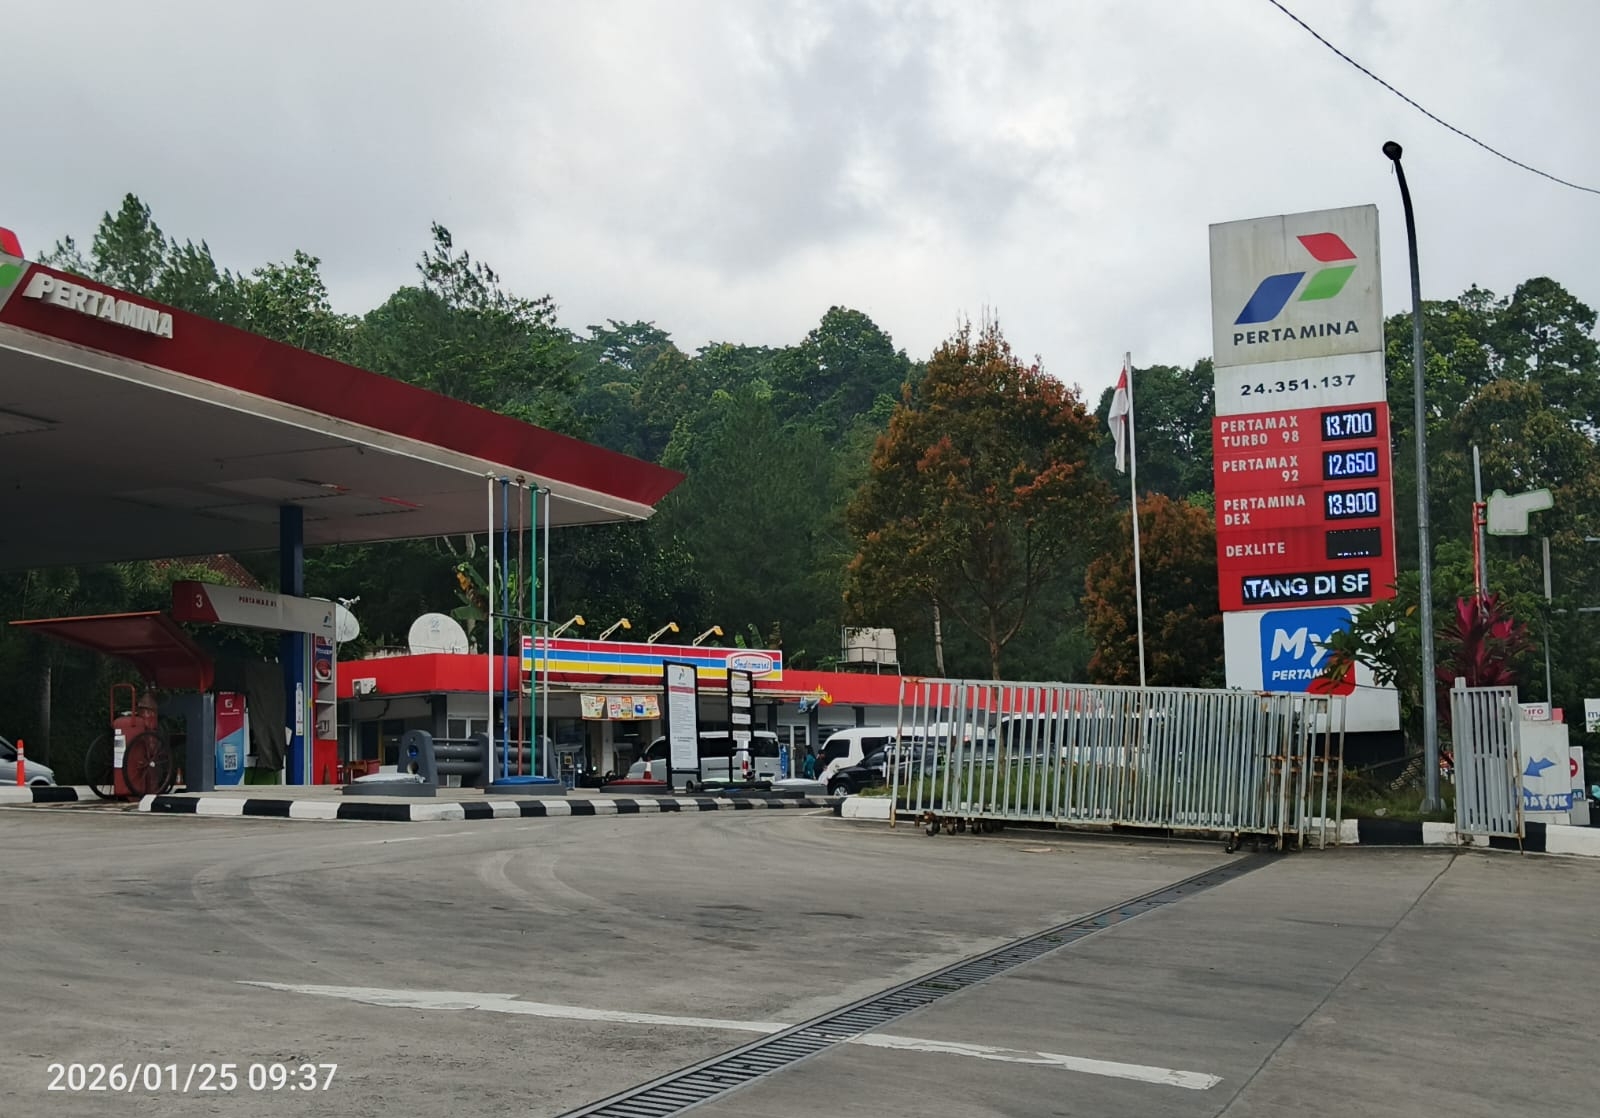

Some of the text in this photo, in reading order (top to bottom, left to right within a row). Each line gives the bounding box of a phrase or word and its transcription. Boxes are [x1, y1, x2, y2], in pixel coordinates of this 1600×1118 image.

[22, 272, 173, 339] PERTAMINA
[1233, 320, 1359, 346] PERTAMINA
[1240, 374, 1356, 396] 24.351.137
[1221, 415, 1298, 433] PERTAMAX
[1326, 412, 1372, 436] 13.700
[1222, 430, 1300, 447] TURBO 98
[1222, 455, 1298, 472] PERTAMAX
[1328, 451, 1376, 476] 12.650
[1282, 470, 1299, 482] 92
[1224, 494, 1306, 511] PERTAMINA
[1328, 491, 1377, 515] 13.900
[1224, 512, 1250, 526] DEX
[1226, 542, 1285, 557] DEXLITE
[1243, 577, 1308, 599] TANG
[1314, 575, 1336, 595] DI
[196, 594, 203, 608] 3
[1272, 667, 1332, 681] PERTAM
